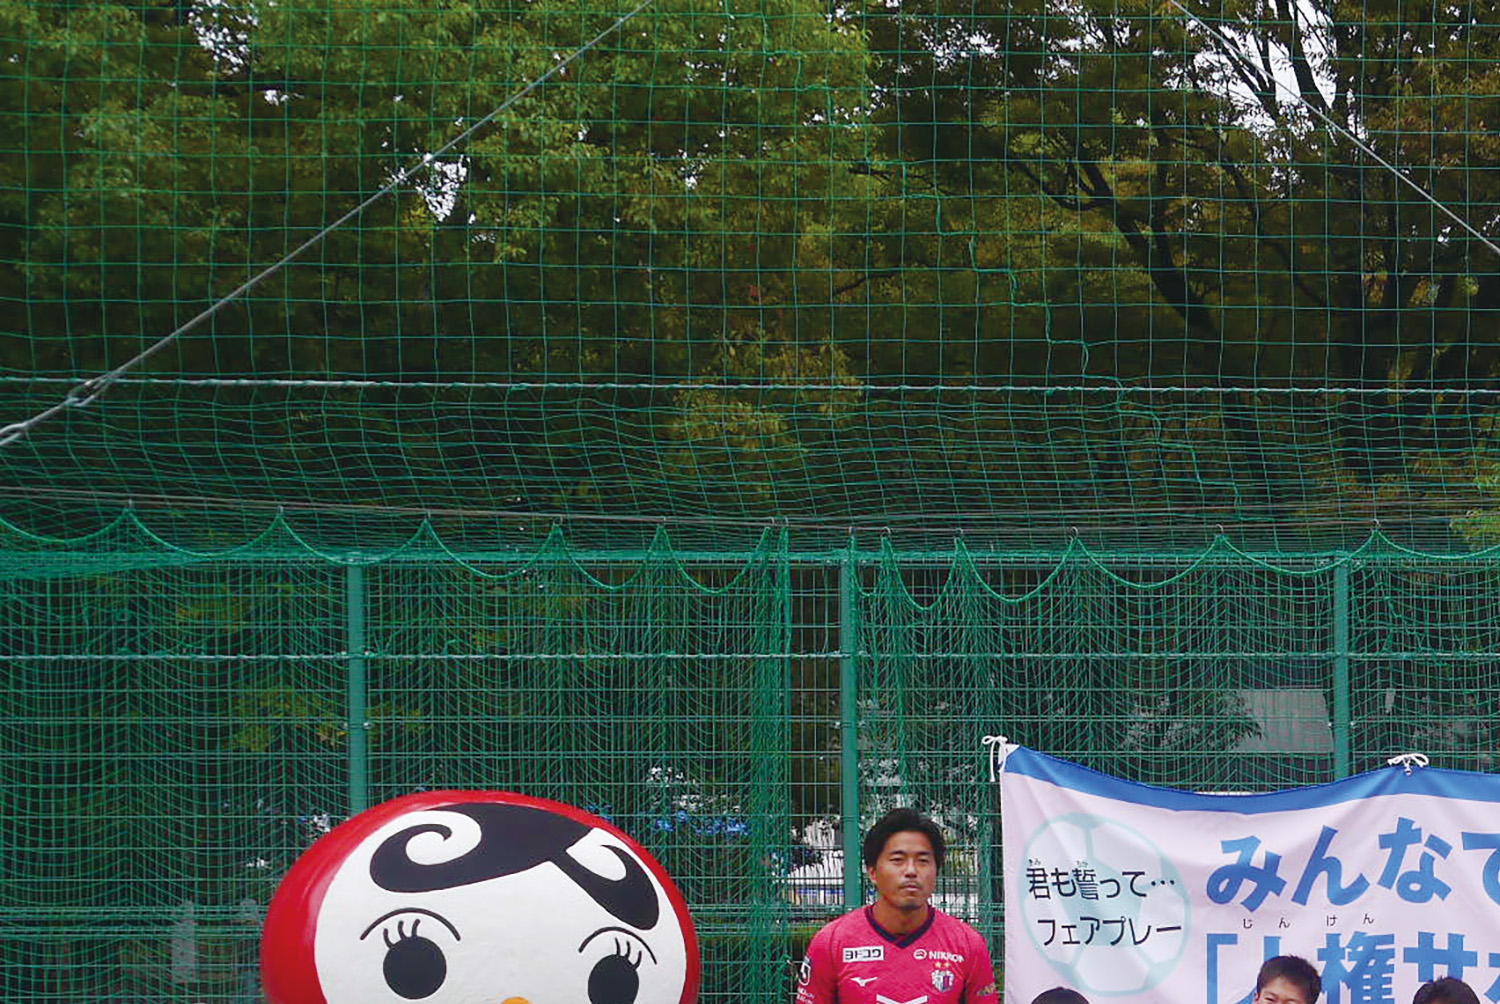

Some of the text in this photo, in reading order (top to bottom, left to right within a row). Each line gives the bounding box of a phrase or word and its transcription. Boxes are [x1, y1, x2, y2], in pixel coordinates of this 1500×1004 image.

[1037, 915, 1183, 946] フェアプレー
